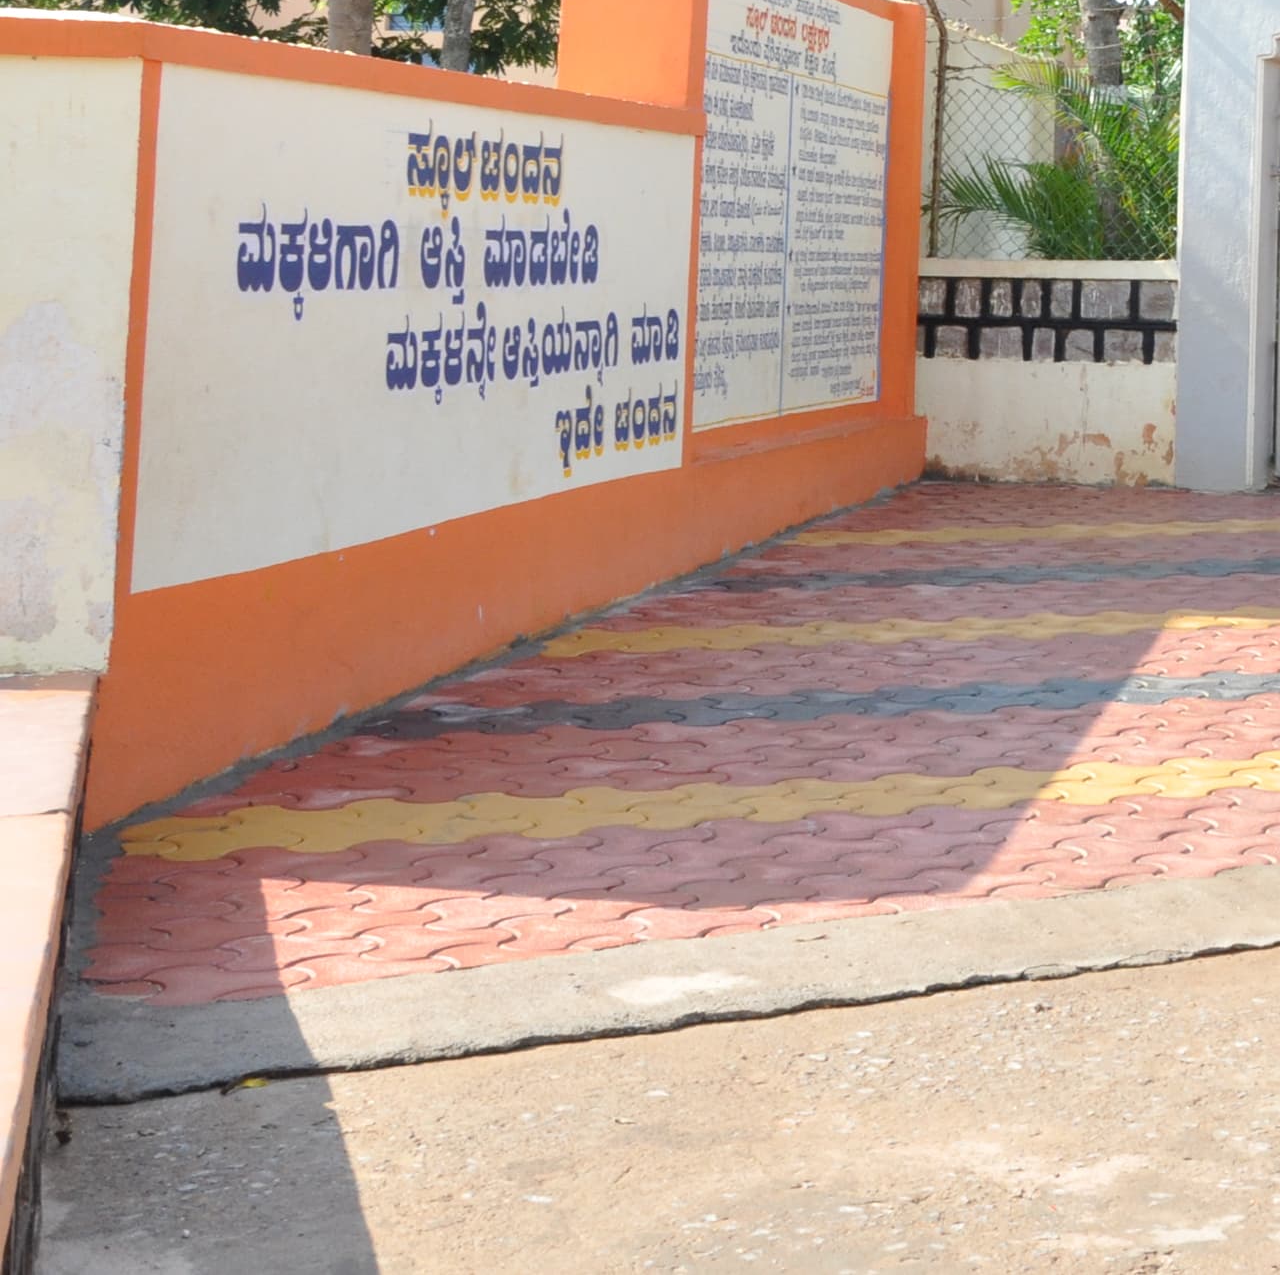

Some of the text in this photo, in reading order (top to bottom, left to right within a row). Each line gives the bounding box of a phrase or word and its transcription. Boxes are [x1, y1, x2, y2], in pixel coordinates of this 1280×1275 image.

[407, 118, 564, 219] ಸ್ಕೂಲ್ ಚಂದನ
[236, 202, 599, 321] ಮಕ್ಕಳಿಗಾಗಿ ಆಸ್ತಿ ಮಾಡಬೇಡಿ
[386, 301, 679, 405] ಮಕ್ಕಳನ್ನೇ ಆಸ್ತಿಯನ್ನಾಗಿ ಮಾಡಿ
[555, 379, 678, 478] ಇದೇ ಚಂದನ
